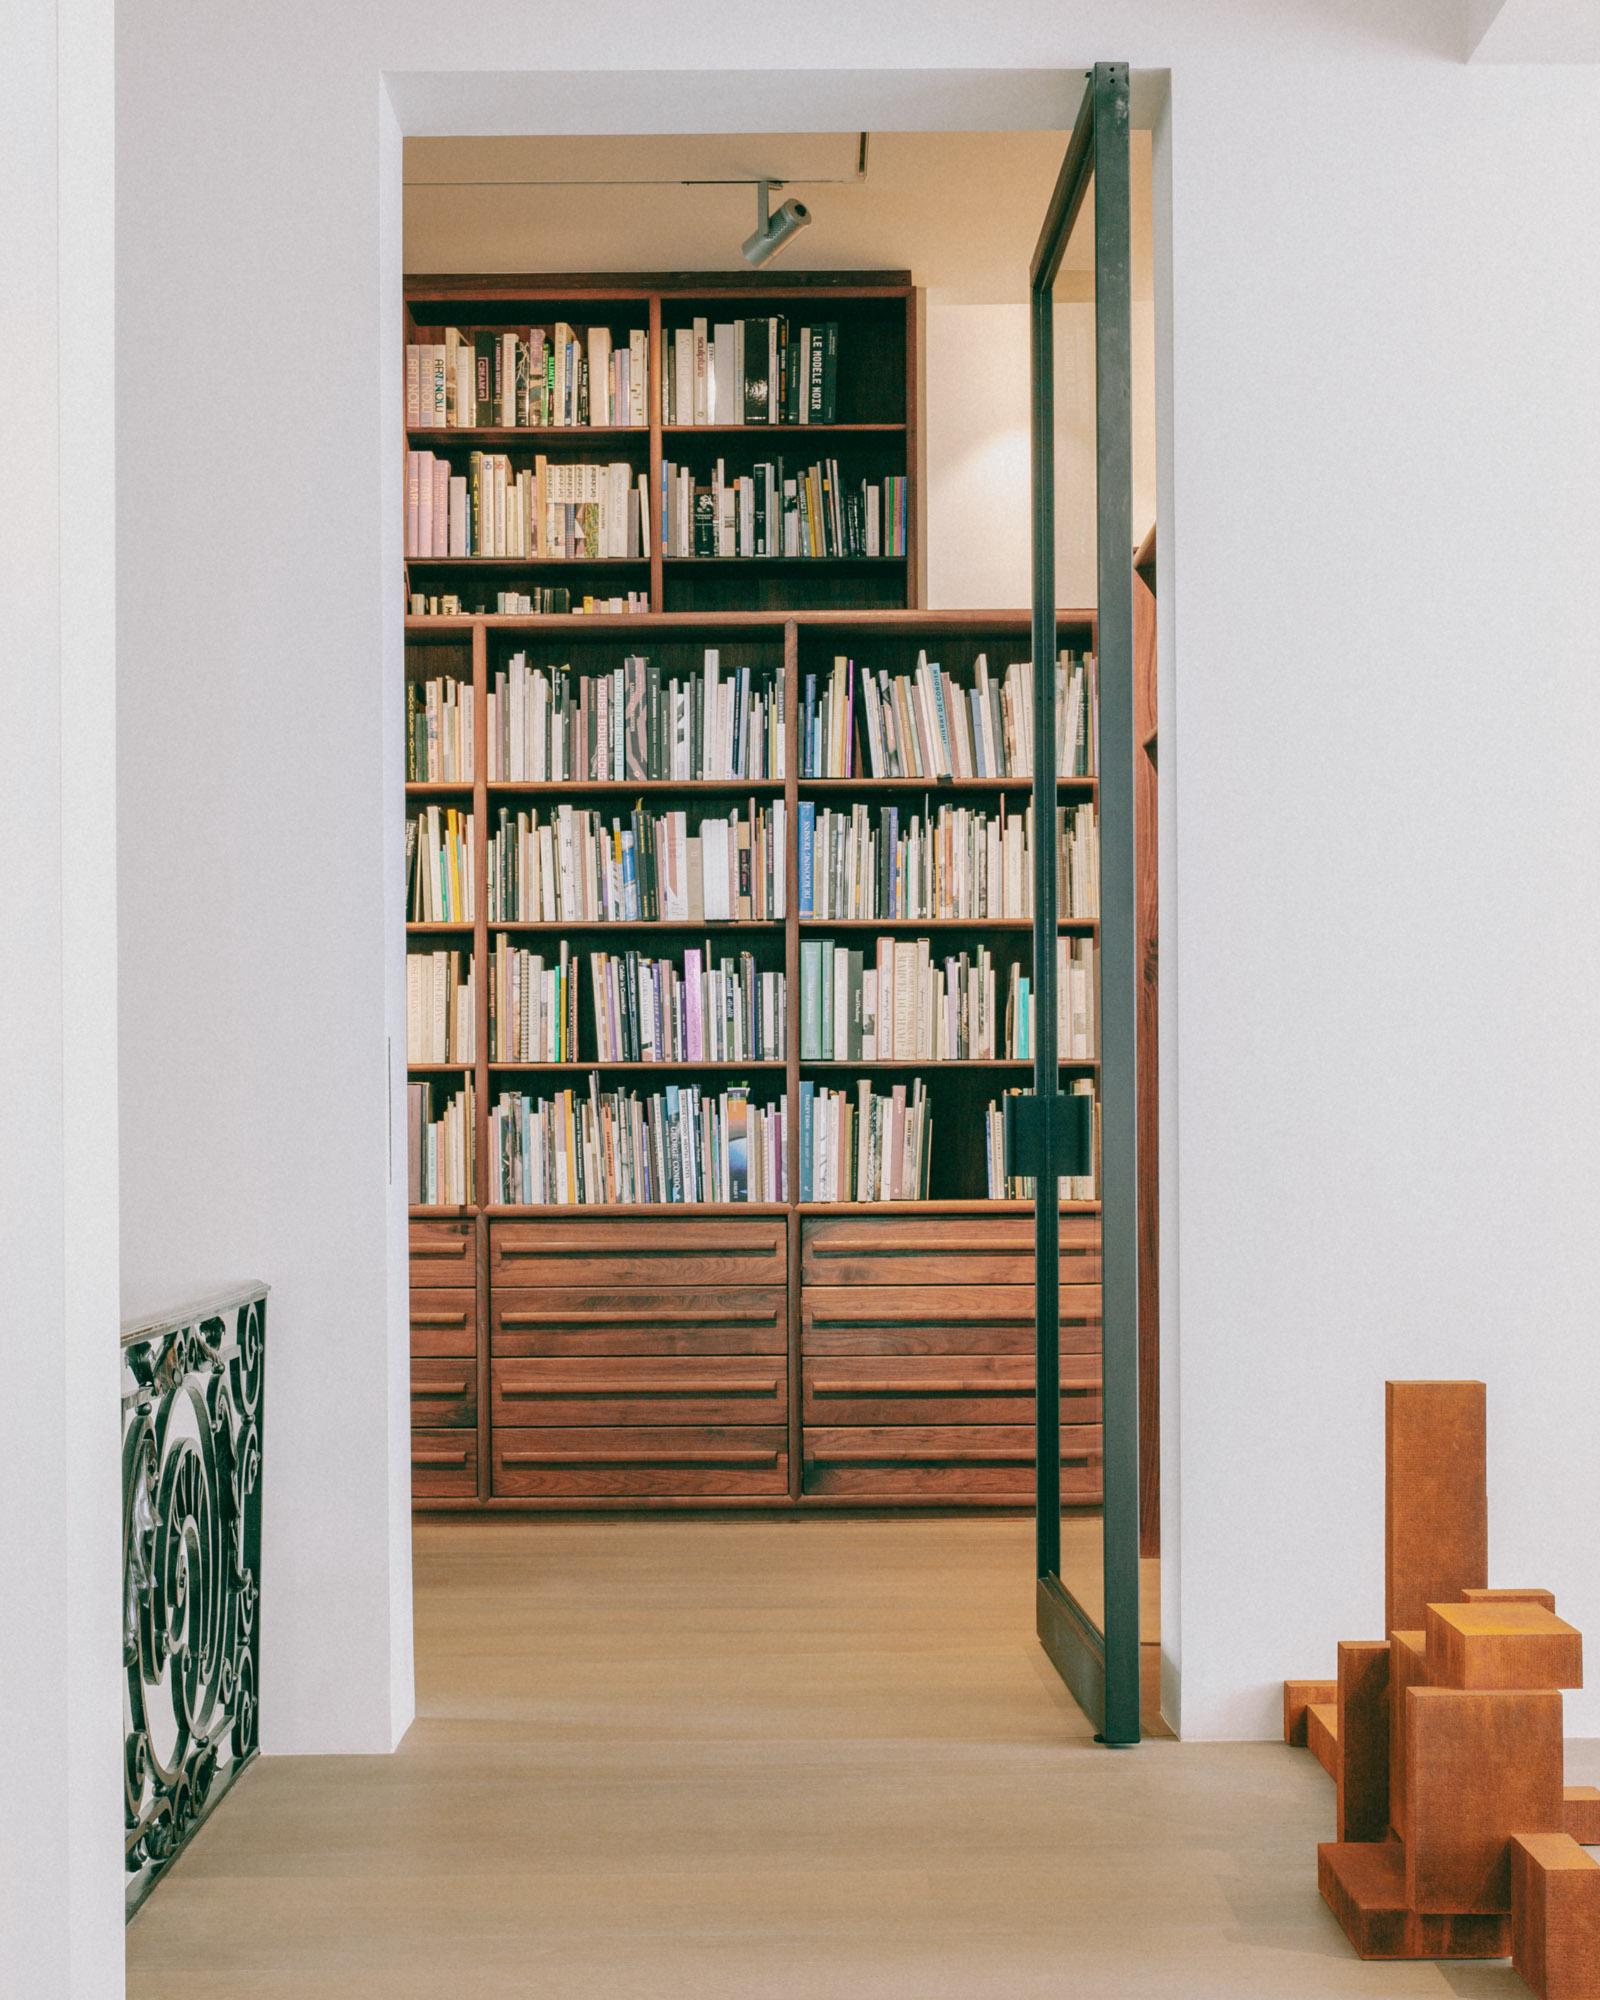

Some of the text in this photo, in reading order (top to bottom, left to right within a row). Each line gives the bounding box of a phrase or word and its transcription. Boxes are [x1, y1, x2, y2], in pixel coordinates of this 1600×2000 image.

[696, 336, 704, 378] sculpture
[813, 336, 822, 347] LE
[408, 359, 418, 413] ART NOW
[422, 359, 432, 413] ART NOW
[435, 359, 444, 413] ART NOW
[478, 360, 486, 390] CREAM
[812, 387, 821, 410] NOIR
[598, 680, 608, 780] LOUISE BOURGEOIS
[671, 1126, 681, 1189] GEORGE CONDO
